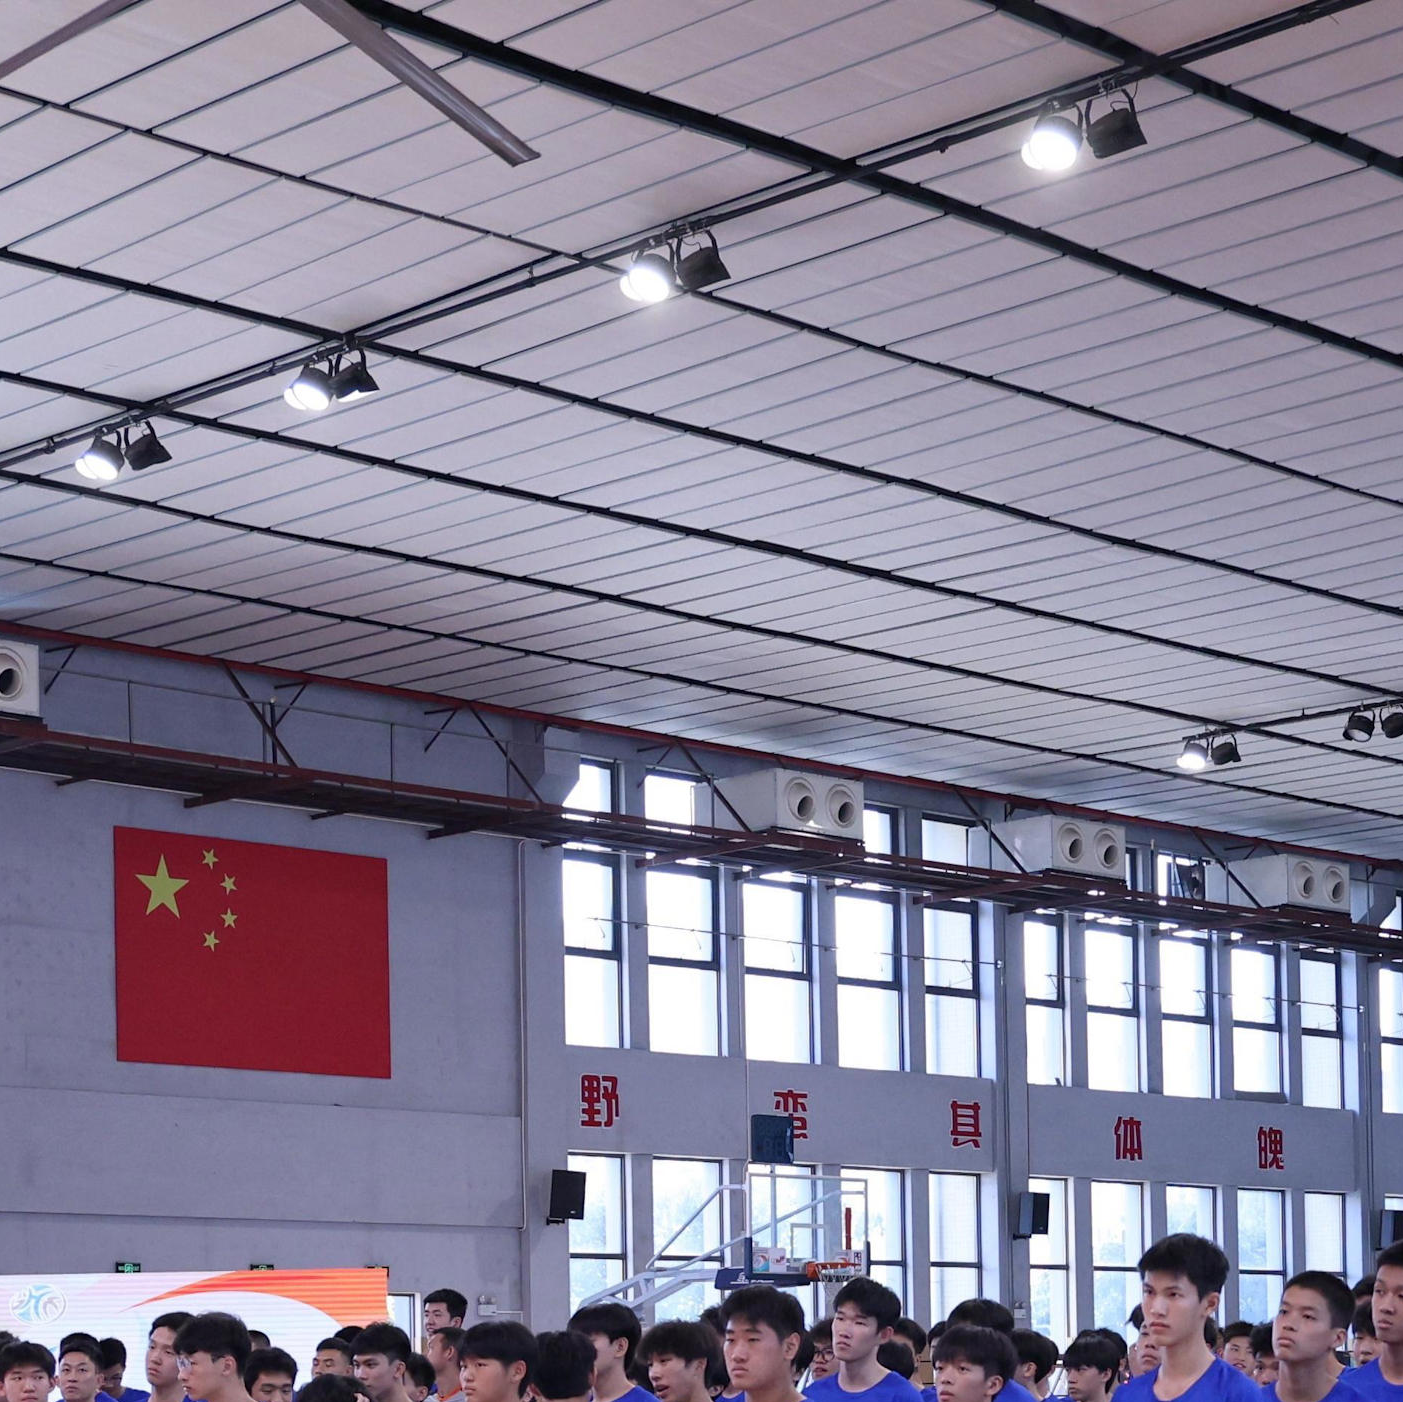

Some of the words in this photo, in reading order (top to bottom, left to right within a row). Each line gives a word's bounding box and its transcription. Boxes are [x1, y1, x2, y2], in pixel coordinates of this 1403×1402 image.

[580, 1073, 620, 1128] 野
[949, 1099, 982, 1149] 其
[1113, 1114, 1144, 1163] 体
[1257, 1126, 1285, 1171] 魄
